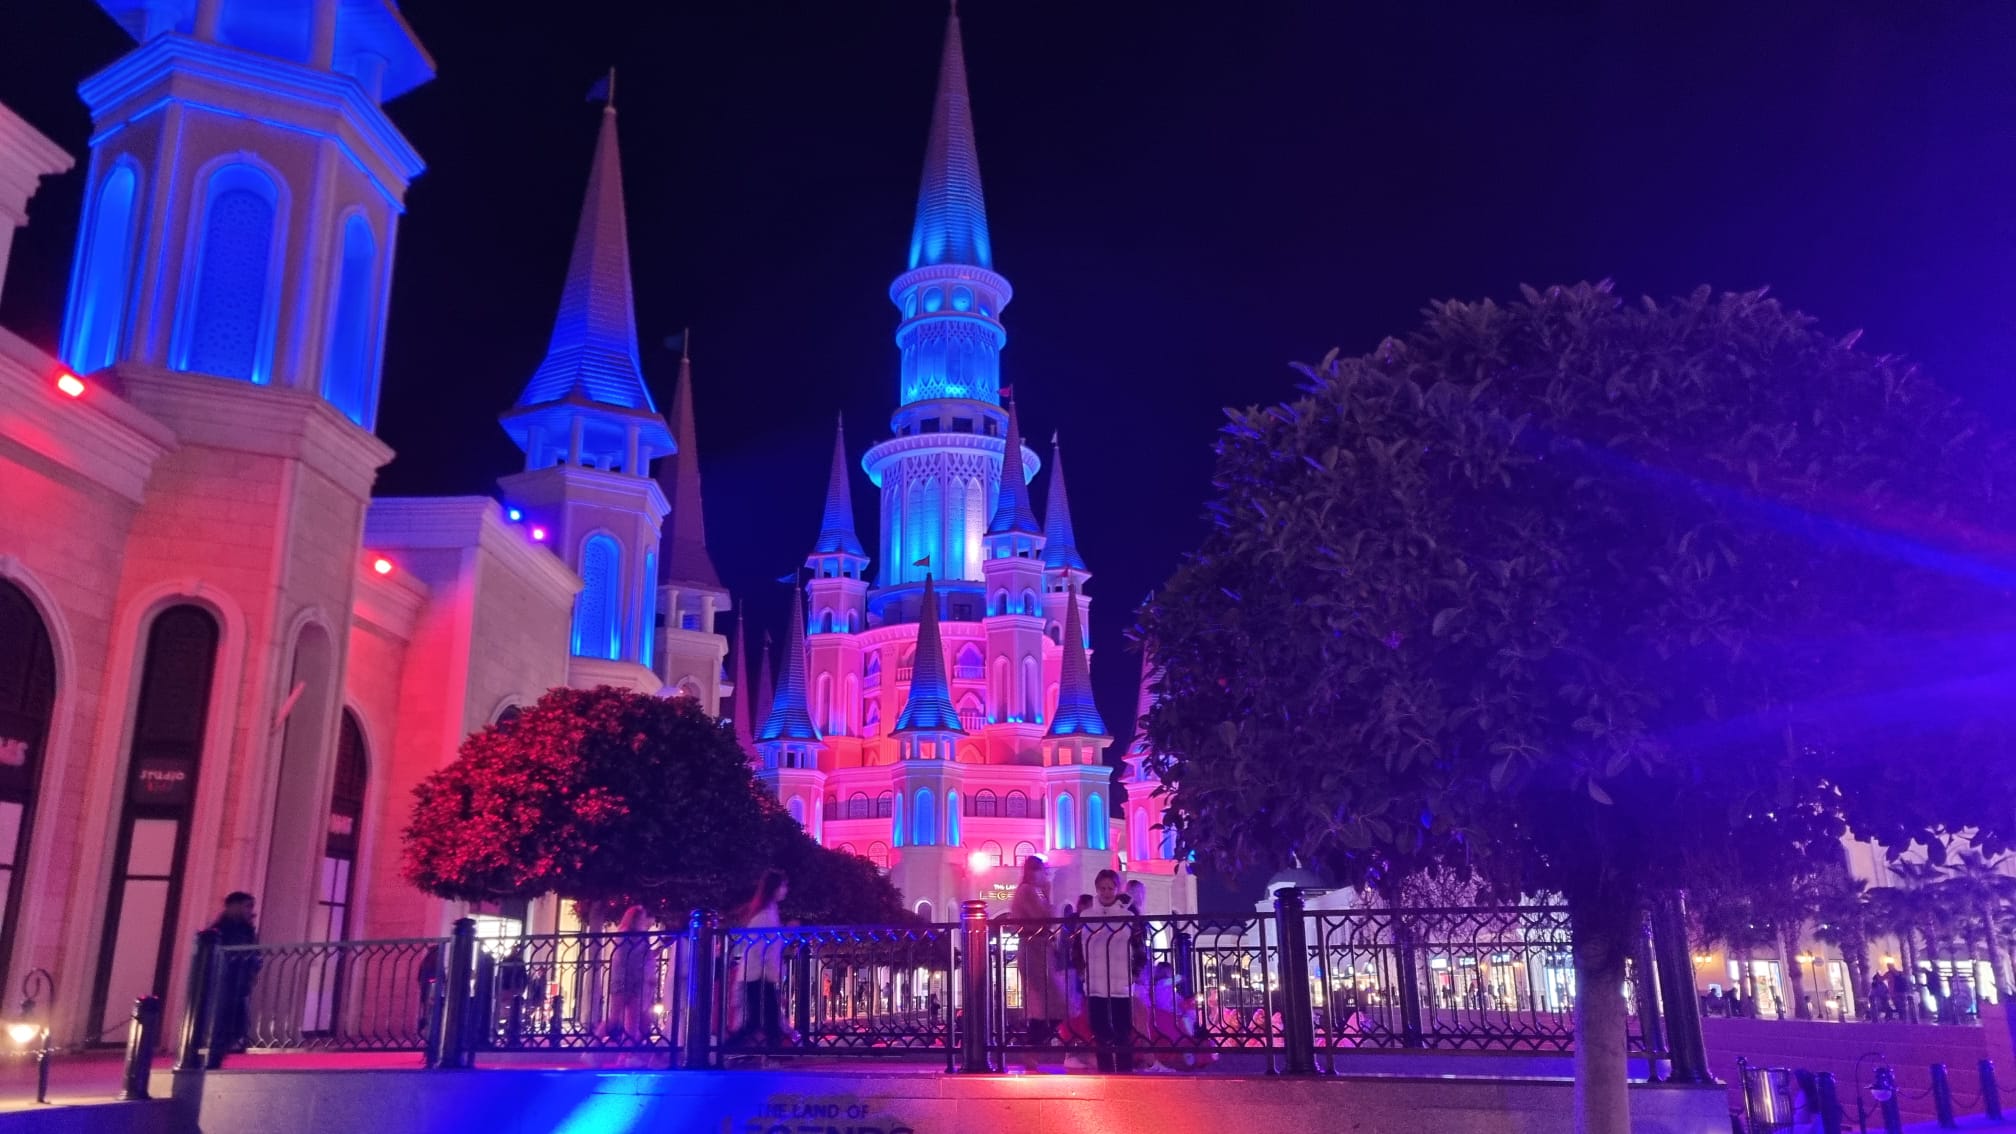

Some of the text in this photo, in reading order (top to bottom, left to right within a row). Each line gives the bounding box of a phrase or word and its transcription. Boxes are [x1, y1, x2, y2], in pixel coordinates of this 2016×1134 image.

[758, 1104, 870, 1118] THE LAND OF
